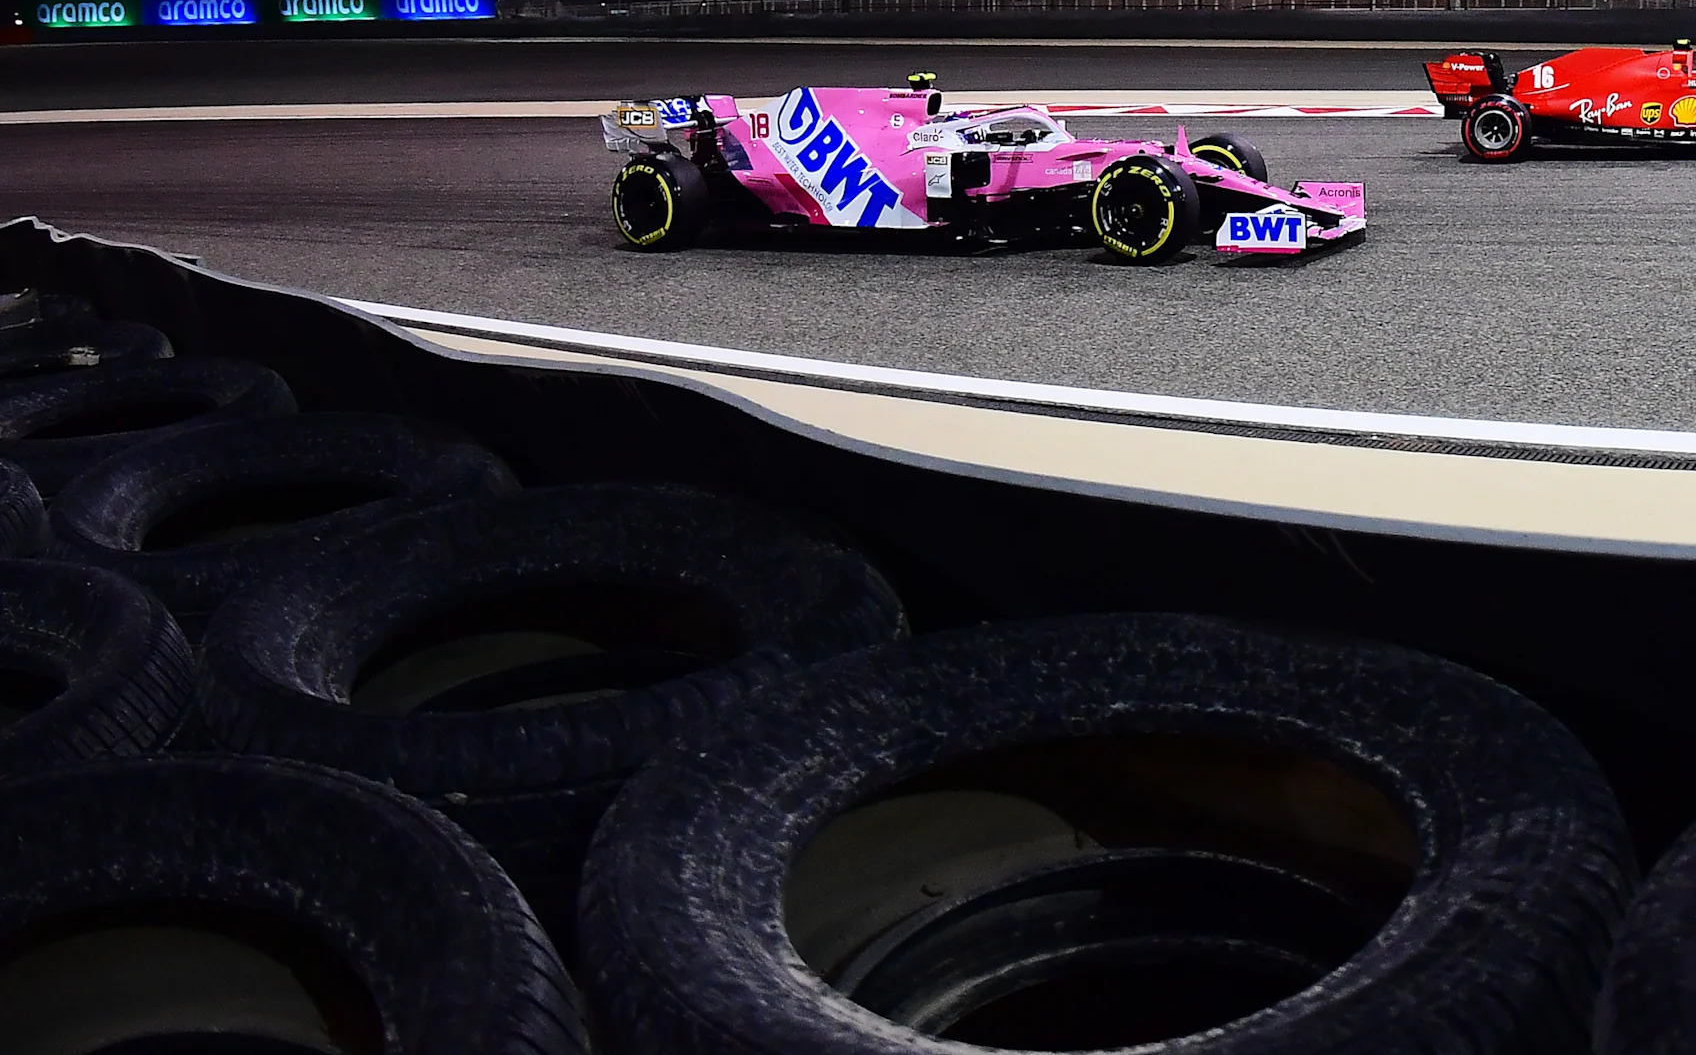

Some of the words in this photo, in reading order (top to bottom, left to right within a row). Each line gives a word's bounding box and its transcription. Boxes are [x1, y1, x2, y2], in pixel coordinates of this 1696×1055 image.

[37, 2, 126, 23] aramco
[1451, 63, 1485, 71] V-Power
[1532, 65, 1555, 89] 16
[621, 112, 654, 125] JCB
[1642, 109, 1659, 122] ups
[750, 114, 769, 139] 18
[622, 164, 655, 182] ZERO
[796, 120, 899, 227] BWT
[1128, 166, 1171, 197] ZERO
[1318, 186, 1361, 198] Acronis
[1229, 216, 1302, 243] BWT
